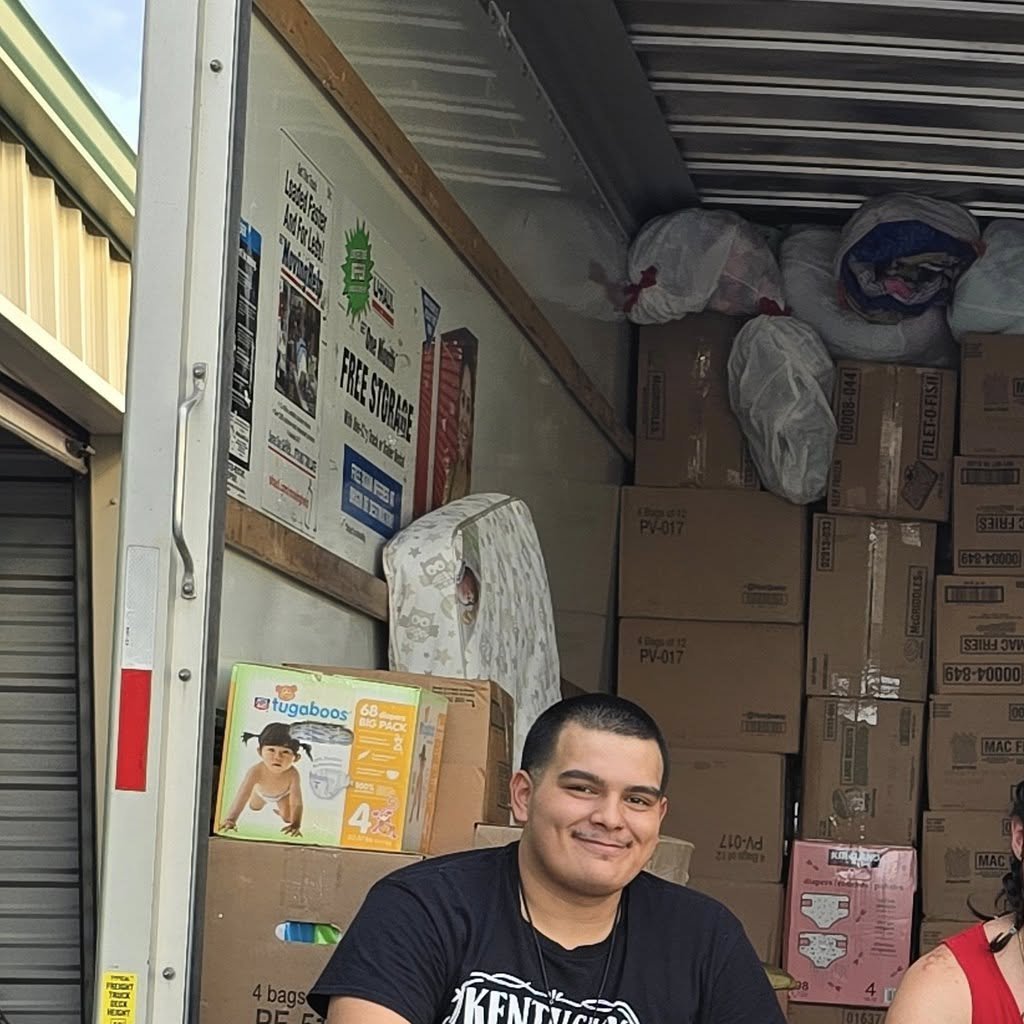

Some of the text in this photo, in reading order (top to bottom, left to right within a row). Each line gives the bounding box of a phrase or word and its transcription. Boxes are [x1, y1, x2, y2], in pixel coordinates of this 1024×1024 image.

[340, 347, 369, 407] FREE
[369, 372, 414, 443] STORAGE
[640, 520, 684, 535] PV-017
[979, 517, 1015, 530] FRIES
[963, 638, 998, 651] FRIES
[640, 649, 684, 664] PV-017
[945, 666, 1020, 682] 00004-849
[272, 698, 348, 721] tugaboos
[360, 703, 378, 717] 68
[359, 718, 407, 734] BIG PACK
[984, 740, 1014, 754] MAC
[349, 802, 372, 834] 4
[719, 833, 763, 850] PV-017
[978, 853, 1006, 867] MAC
[252, 984, 306, 1009] 4 bags
[865, 982, 877, 997] 4
[847, 1011, 881, 1024] 01637
